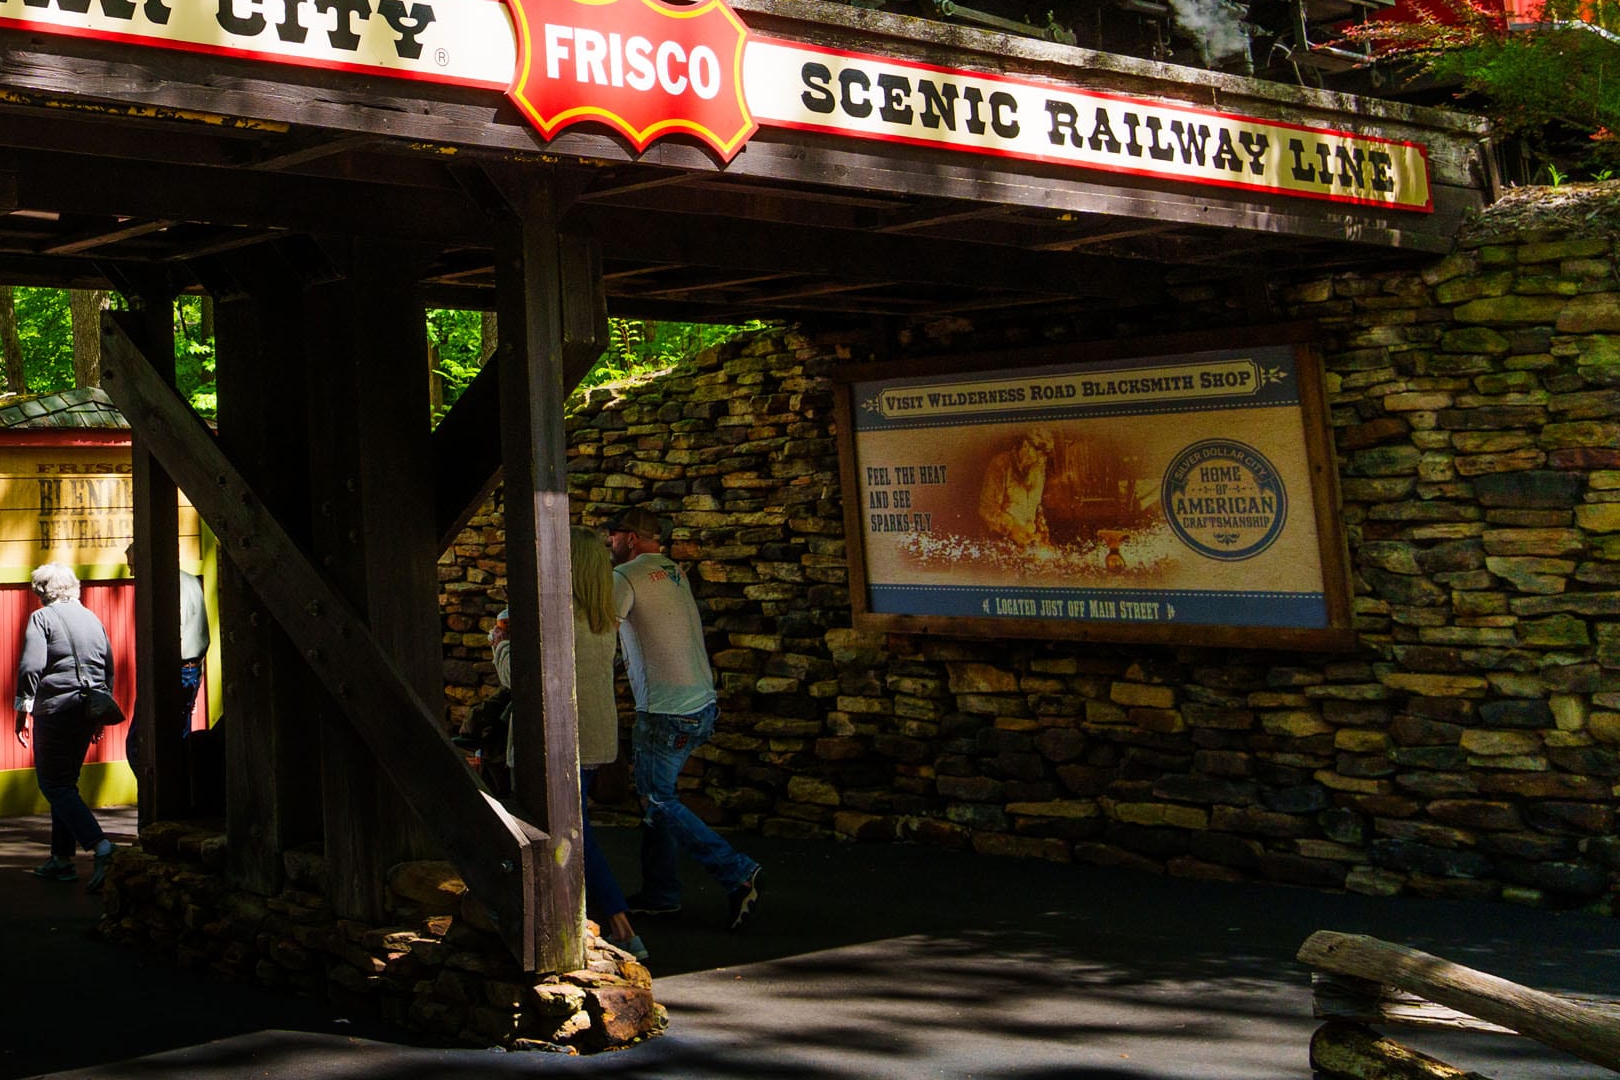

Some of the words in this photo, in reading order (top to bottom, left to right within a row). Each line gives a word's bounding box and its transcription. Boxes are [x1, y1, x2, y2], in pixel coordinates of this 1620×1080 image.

[544, 23, 721, 100] FRISCO
[800, 61, 1021, 139] SCENIC
[1044, 98, 1270, 176] RAILWAY
[1287, 138, 1396, 193] LINE
[885, 395, 924, 411] VISIT
[927, 387, 1026, 408] WILDERNESS
[1030, 383, 1077, 401] ROAD
[1082, 375, 1195, 397] BLACKSMITH
[1199, 371, 1252, 389] SHOP
[36, 463, 132, 474] FRISC
[1174, 452, 1202, 482] SILVER
[1202, 447, 1245, 460] DOLLAR
[1245, 456, 1269, 478] CITY
[1200, 466, 1241, 482] HOME
[867, 467, 891, 486] FEEL
[895, 466, 916, 485] THE
[920, 465, 947, 484] HEAT
[38, 479, 133, 516] BLENDE
[869, 490, 889, 509] AND
[893, 489, 911, 508] SEE
[1215, 484, 1228, 495] OF
[1176, 496, 1275, 515] AMERICAN
[871, 513, 910, 532] SPARKS
[913, 513, 932, 532] FLY
[1183, 516, 1270, 529] CRAFTSMANSHIP
[995, 597, 1037, 616] LOCATED
[1040, 599, 1064, 617] JUST
[1067, 600, 1085, 617] OFF
[1088, 599, 1116, 619] MAIN
[1120, 600, 1159, 620] STREET
